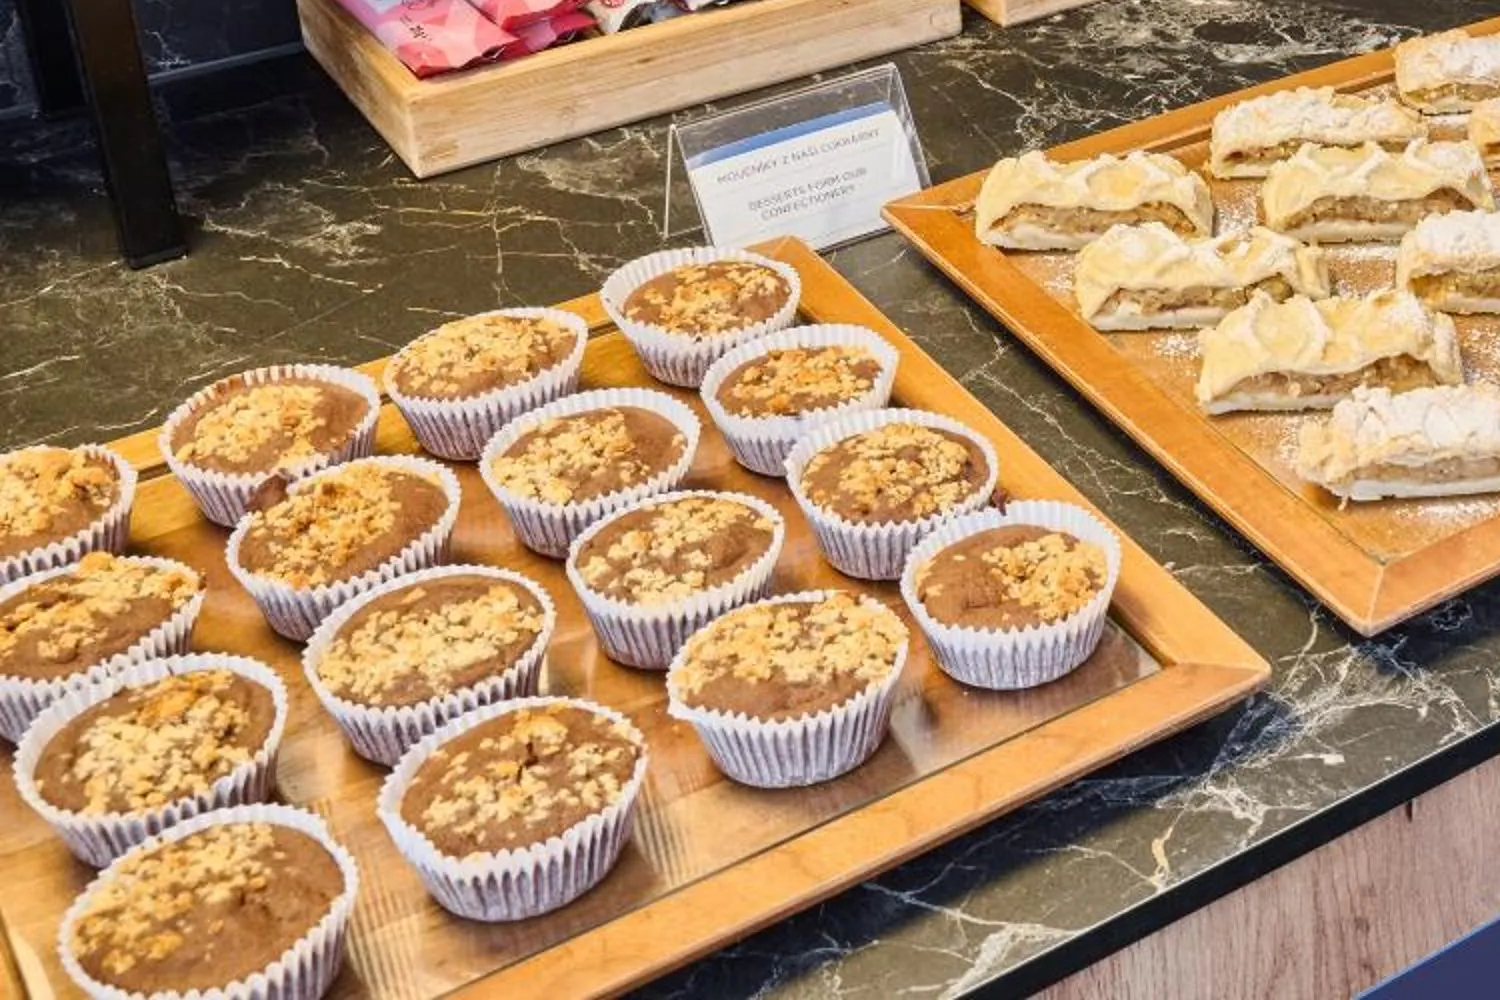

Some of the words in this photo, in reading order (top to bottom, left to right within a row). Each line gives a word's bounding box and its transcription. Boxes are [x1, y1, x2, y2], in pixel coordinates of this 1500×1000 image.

[748, 184, 807, 211] DESSERTS
[842, 167, 868, 182] OUR
[760, 185, 857, 221] CONFECTIONERY
